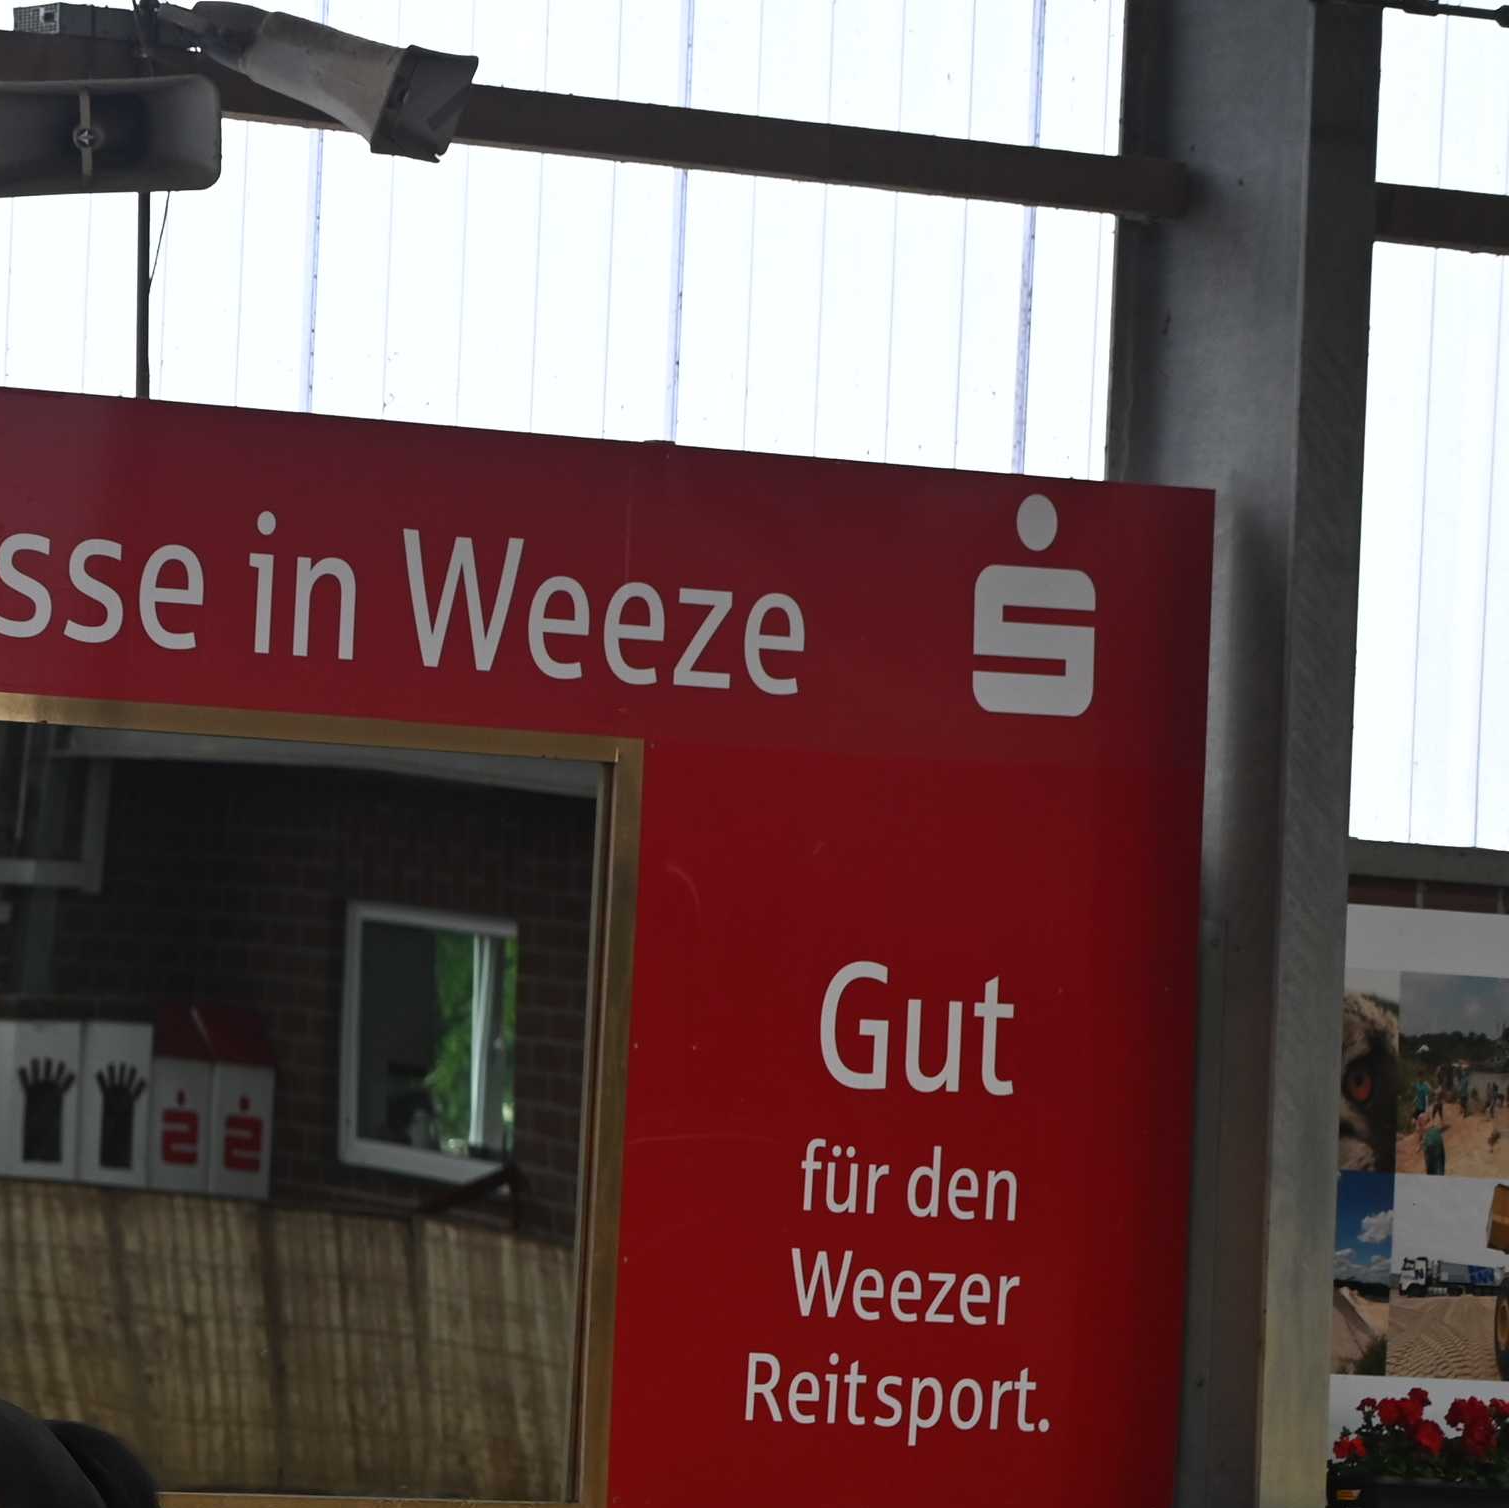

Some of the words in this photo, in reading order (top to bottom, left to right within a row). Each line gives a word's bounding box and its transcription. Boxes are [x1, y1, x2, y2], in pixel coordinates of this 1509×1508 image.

[250, 511, 356, 660] in
[403, 529, 804, 695] Weeze
[821, 961, 1014, 1095] Gut
[802, 1139, 889, 1214] für
[908, 1146, 1017, 1221] den
[792, 1248, 1020, 1325] Weezer
[745, 1353, 1049, 1446] Reitsport.
